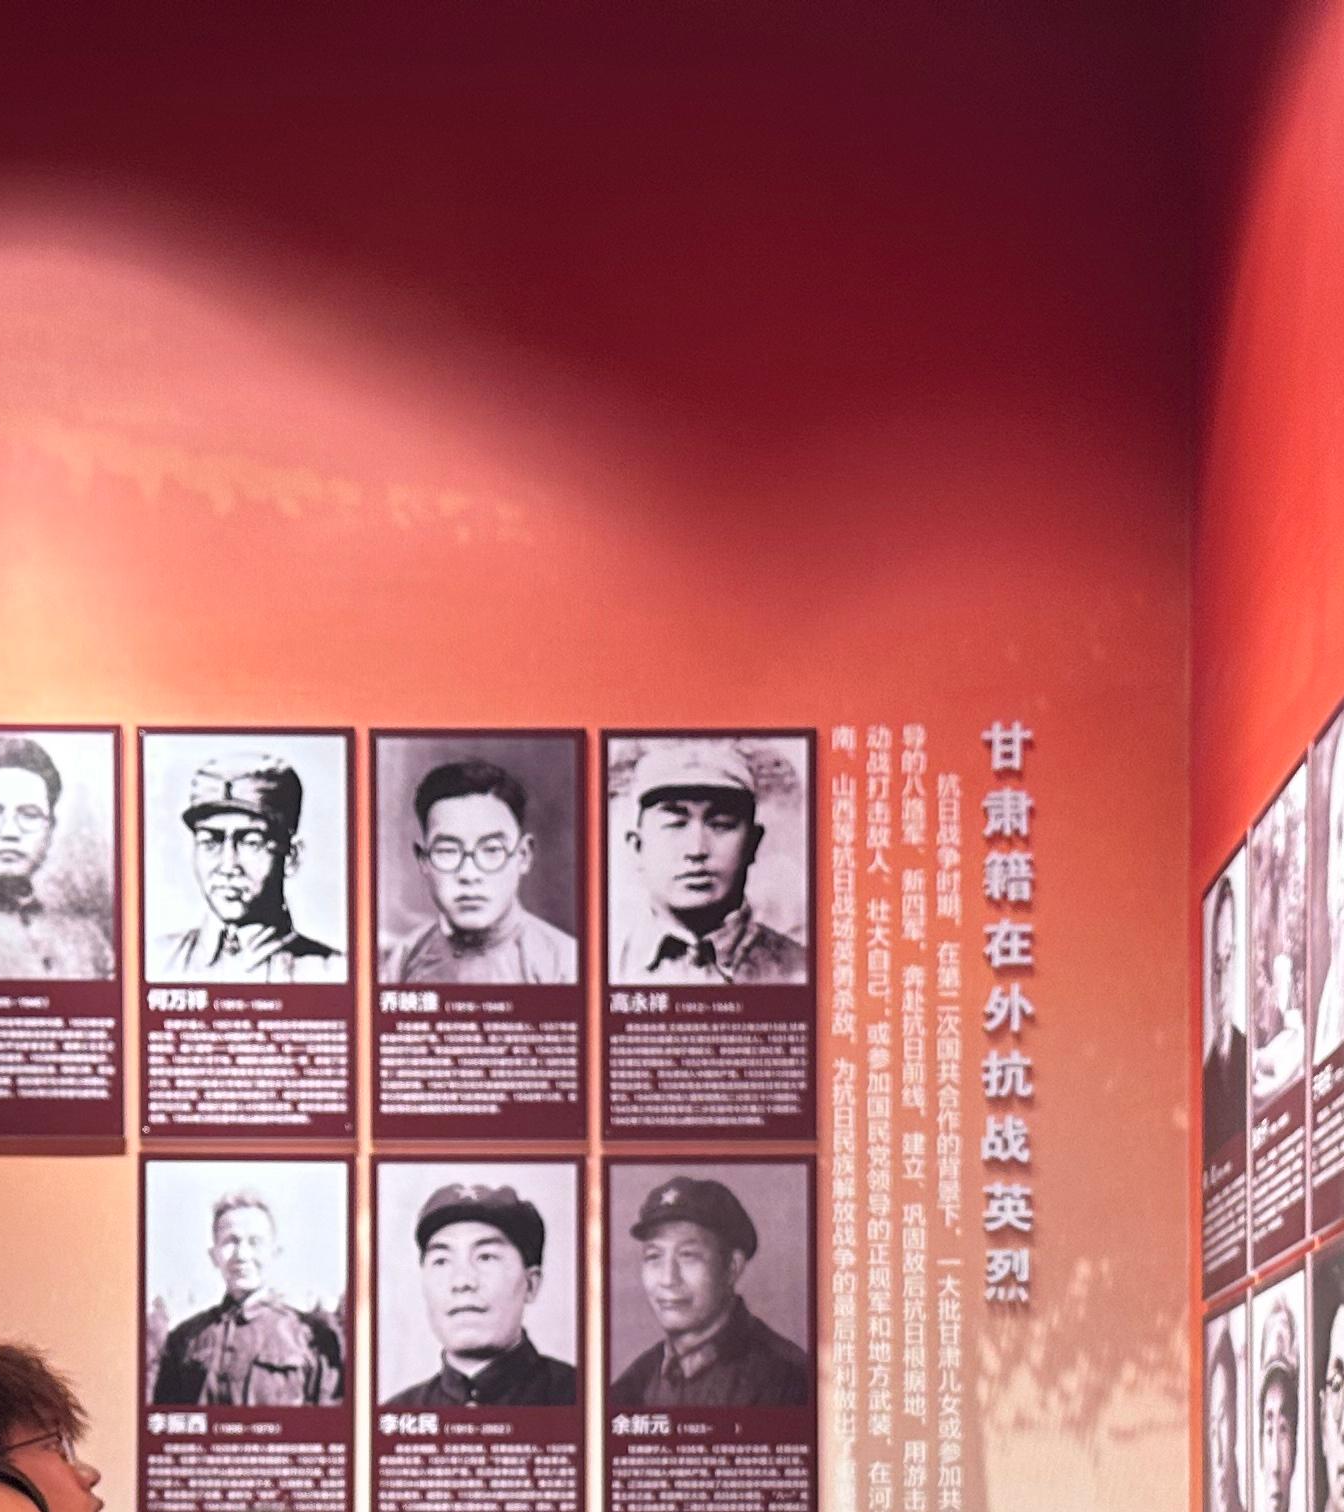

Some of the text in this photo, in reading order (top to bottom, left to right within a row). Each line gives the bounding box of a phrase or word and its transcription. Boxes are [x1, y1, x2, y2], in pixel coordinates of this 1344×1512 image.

[980, 720, 1034, 1302] 甘肃籍在外抗战英烈
[378, 1413, 439, 1436] 李化民
[611, 1412, 671, 1436] 余新元
